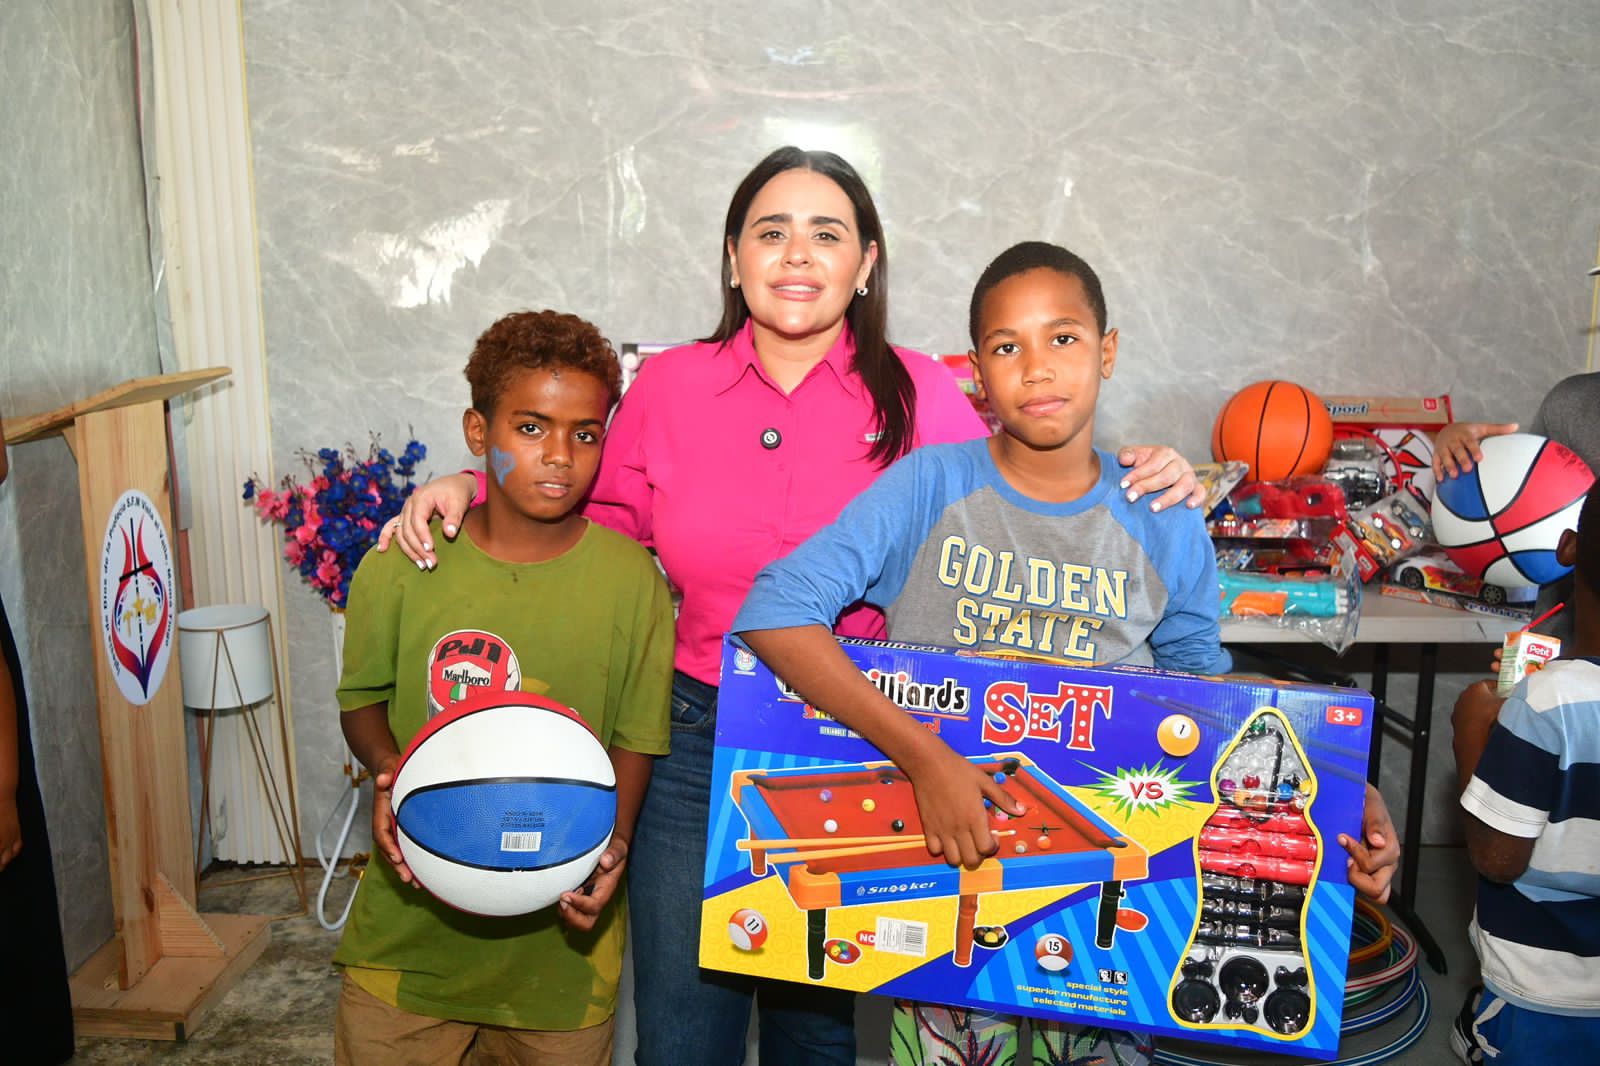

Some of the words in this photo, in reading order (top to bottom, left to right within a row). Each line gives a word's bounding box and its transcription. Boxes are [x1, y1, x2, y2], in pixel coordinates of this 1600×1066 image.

[938, 535, 1129, 618] GOLDEN
[953, 597, 1104, 660] STATE
[1529, 645, 1551, 657] Petit
[444, 668, 490, 685] Marlboro
[1333, 709, 1357, 723] 3+
[1128, 781, 1164, 800] VS
[867, 881, 937, 894] Snooker
[747, 918, 760, 932] 11
[1048, 941, 1060, 952] 15
[1016, 984, 1060, 996] superior
[1061, 990, 1128, 1006] manufacture
[1066, 982, 1102, 992] special
[1103, 987, 1129, 996] style
[1033, 997, 1077, 1009] selected
[1078, 1003, 1127, 1016] materials
